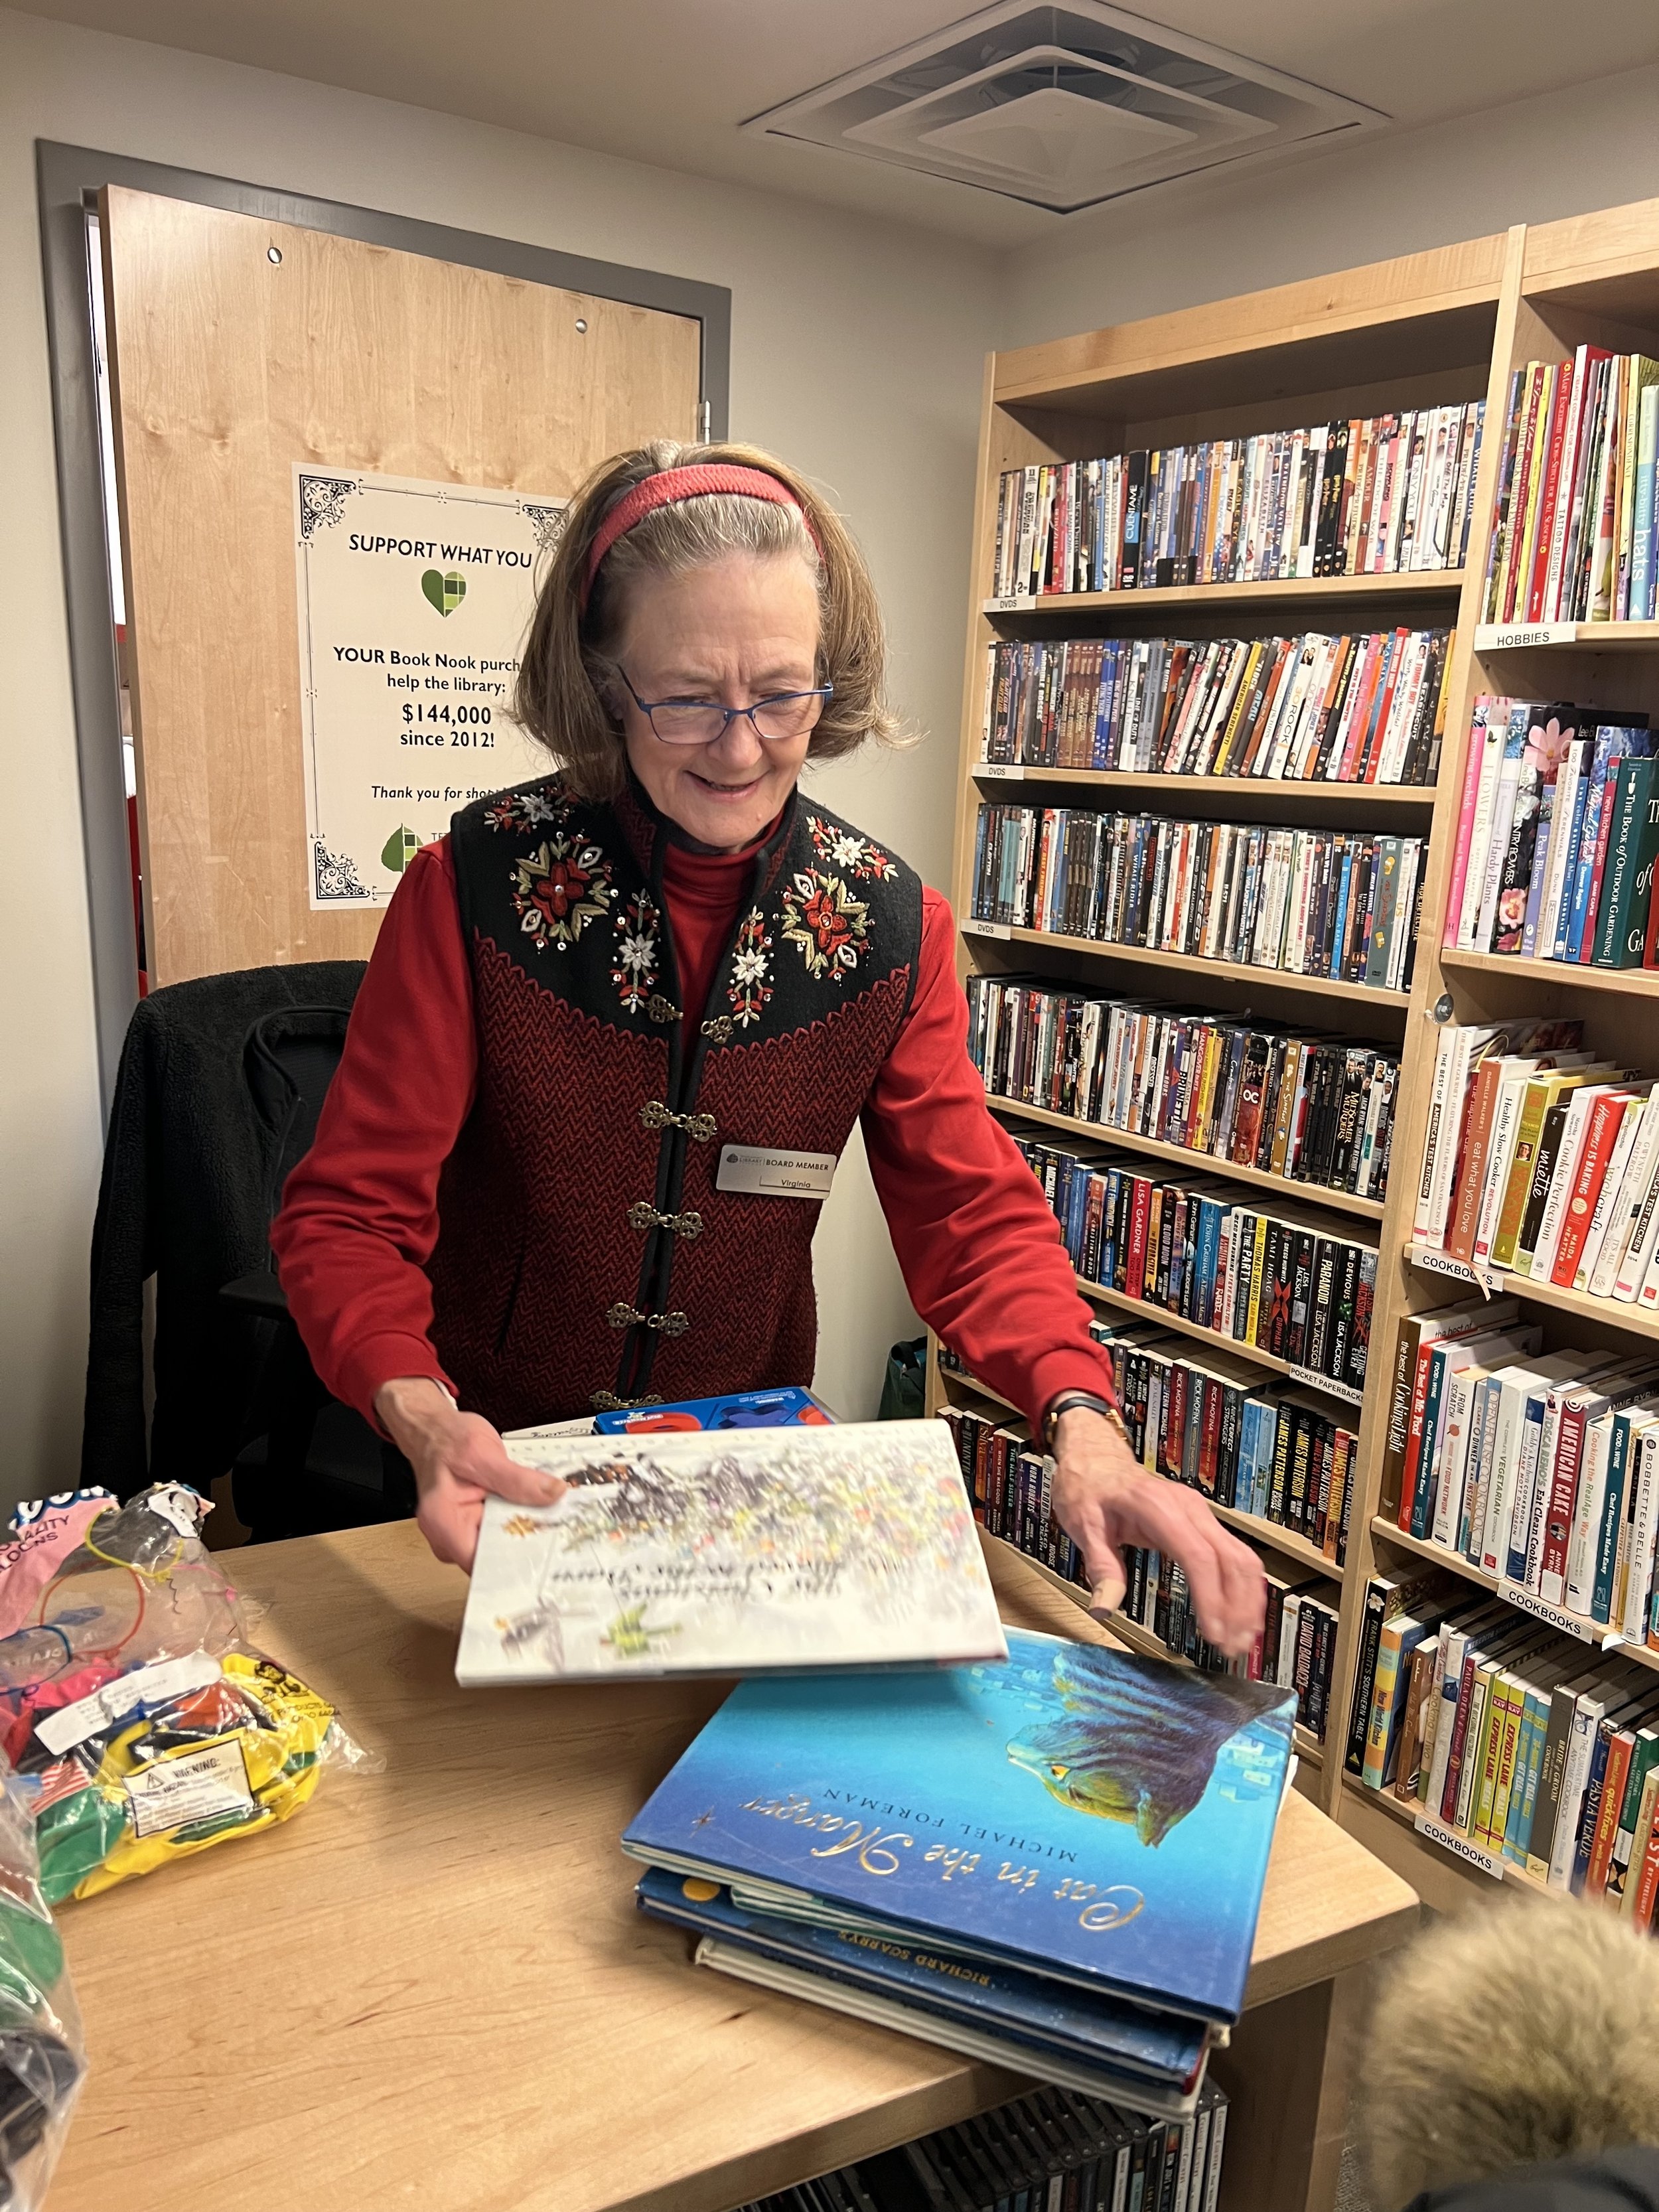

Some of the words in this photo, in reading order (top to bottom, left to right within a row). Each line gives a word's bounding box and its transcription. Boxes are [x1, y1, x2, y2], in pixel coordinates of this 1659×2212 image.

[1363, 466, 1373, 502] AMOUR
[1409, 459, 1421, 488] ONLY
[1406, 490, 1417, 514] YOU
[1636, 475, 1649, 525] itty-bitty
[1555, 509, 1566, 543] TATTOO
[348, 534, 437, 559] SUPPORT
[440, 544, 493, 565] WHAT
[496, 550, 532, 569] YOU
[1551, 546, 1561, 582] DESIGNS
[1632, 529, 1651, 582] hats
[1000, 599, 1017, 608] DVDS
[1497, 632, 1550, 646] HOBBIES
[333, 646, 385, 664] YOUR
[390, 651, 431, 667] Book
[435, 654, 476, 670] Nook
[480, 656, 521, 674] purch
[387, 673, 419, 691] help
[425, 676, 450, 691] the
[453, 677, 506, 696] library:
[1234, 680, 1248, 711] AMERICAN
[402, 703, 492, 726] $144,000
[1223, 712, 1239, 745] SERENGETI
[400, 731, 445, 747] since
[451, 731, 495, 748] 2012!
[1465, 733, 1480, 773] growing
[372, 785, 411, 799] Thank
[416, 787, 440, 802] you
[444, 786, 463, 800] for
[1463, 775, 1476, 810] orchids
[1604, 796, 1613, 812] new
[1624, 794, 1636, 814] THE
[1598, 813, 1611, 839] kitchen
[1619, 816, 1632, 842] BOOK
[1488, 839, 1503, 872] Hardy
[1536, 834, 1548, 857] Peak
[1595, 841, 1605, 865] garden
[1616, 846, 1627, 858] of
[1131, 855, 1139, 882] WHALE
[1531, 859, 1544, 889] Bloom
[1610, 857, 1626, 903] OUTDOOR
[1483, 874, 1497, 905] Plants
[978, 924, 994, 934] DVDS
[1603, 905, 1619, 956] GARDENING
[1437, 1090, 1442, 1100] OF
[1483, 1071, 1492, 1099] DANIELLE
[1337, 1094, 1349, 1141] MURDERS
[1344, 1091, 1359, 1143] MIDSOMER
[1429, 1106, 1440, 1145] AMERICA'S
[1478, 1100, 1487, 1130] WALKER'S
[1499, 1097, 1512, 1131] Healthy
[1473, 1142, 1481, 1159] eat
[1496, 1133, 1506, 1154] Slow
[1588, 1150, 1597, 1159] IS
[796, 1161, 828, 1170] MEMBER
[1468, 1161, 1478, 1187] what
[1490, 1156, 1502, 1187] Cooker
[1532, 1150, 1551, 1199] miette
[1556, 1140, 1575, 1179] Cookie
[782, 1179, 811, 1188] Virginia
[1422, 1165, 1432, 1196] KITCHEN
[1578, 1160, 1596, 1195] BAKING
[1136, 1183, 1145, 1205] LISA
[1463, 1188, 1473, 1209] you
[1461, 1211, 1473, 1233] love
[1482, 1189, 1494, 1234] REVOLUTION
[1541, 1182, 1563, 1240] Perfection
[1133, 1208, 1143, 1253] GARDNER
[1558, 1226, 1571, 1262] HEATTER
[1254, 1242, 1263, 1271] THOMAS
[1565, 1234, 1578, 1259] MAIDA
[1240, 1249, 1252, 1284] PARTY
[1343, 1262, 1354, 1299] DEVIOUS
[1423, 1256, 1492, 1285] COOKBOOS
[1251, 1274, 1261, 1301] HARRIS
[1317, 1259, 1333, 1305] PARANOID
[1333, 1339, 1344, 1376] JACKSON
[1398, 1354, 1407, 1370] best
[1400, 1341, 1409, 1353] the
[1291, 1368, 1317, 1383] POCKET
[1397, 1371, 1406, 1381] of
[1419, 1359, 1428, 1372] The
[1417, 1374, 1426, 1388] Best
[1390, 1383, 1411, 1426] Cooking
[1415, 1398, 1424, 1412] Mr.
[1448, 1382, 1458, 1418] SCRATCH
[1457, 1392, 1467, 1415] FROM
[1278, 1420, 1290, 1447] JAMES
[1411, 1414, 1422, 1436] Food
[1542, 1416, 1553, 1448] TOSCA
[1388, 1428, 1407, 1453] Light
[1421, 1436, 1431, 1461] Recipes
[1555, 1418, 1579, 1481] AMERICAN
[1587, 1432, 1600, 1466] Cooking
[1273, 1446, 1286, 1491] PATTERSON
[1538, 1449, 1551, 1487] RENO'S
[1587, 1467, 1595, 1481] the
[1417, 1479, 1426, 1495] Easy
[1493, 1455, 1507, 1515] VEGETARIAN
[1553, 1483, 1571, 1516] CAKE
[1639, 1453, 1653, 1518] BOBBETTE
[1581, 1483, 1594, 1518] RealAge
[1533, 1507, 1542, 1536] Clean
[1579, 1521, 1589, 1539] Way
[1526, 1538, 1539, 1587] Cookbook
[1634, 1530, 1644, 1569] BELLE
[1508, 1590, 1581, 1634] COOKBOOKS
[1368, 1619, 1378, 1645] FRANK
[1364, 1647, 1374, 1674] STITT'S
[1359, 1675, 1371, 1715] SOUTHERN
[1462, 1665, 1473, 1695] PAULA
[1459, 1696, 1469, 1720] DEEN
[1355, 1717, 1365, 1741] TABLE
[1503, 1723, 1516, 1763] EXPRESS
[1500, 1763, 1510, 1787] LANE
[823, 1788, 944, 1828] FOREMAN
[738, 1793, 914, 1876] Manger
[963, 1822, 1078, 1864] MICHAEL
[1424, 1824, 1492, 1870] COOKBOOKS
[924, 1843, 982, 1881] the
[997, 1861, 1040, 1894] in
[1052, 1876, 1145, 1931] Cat
[915, 1954, 990, 1986] RICHARD
